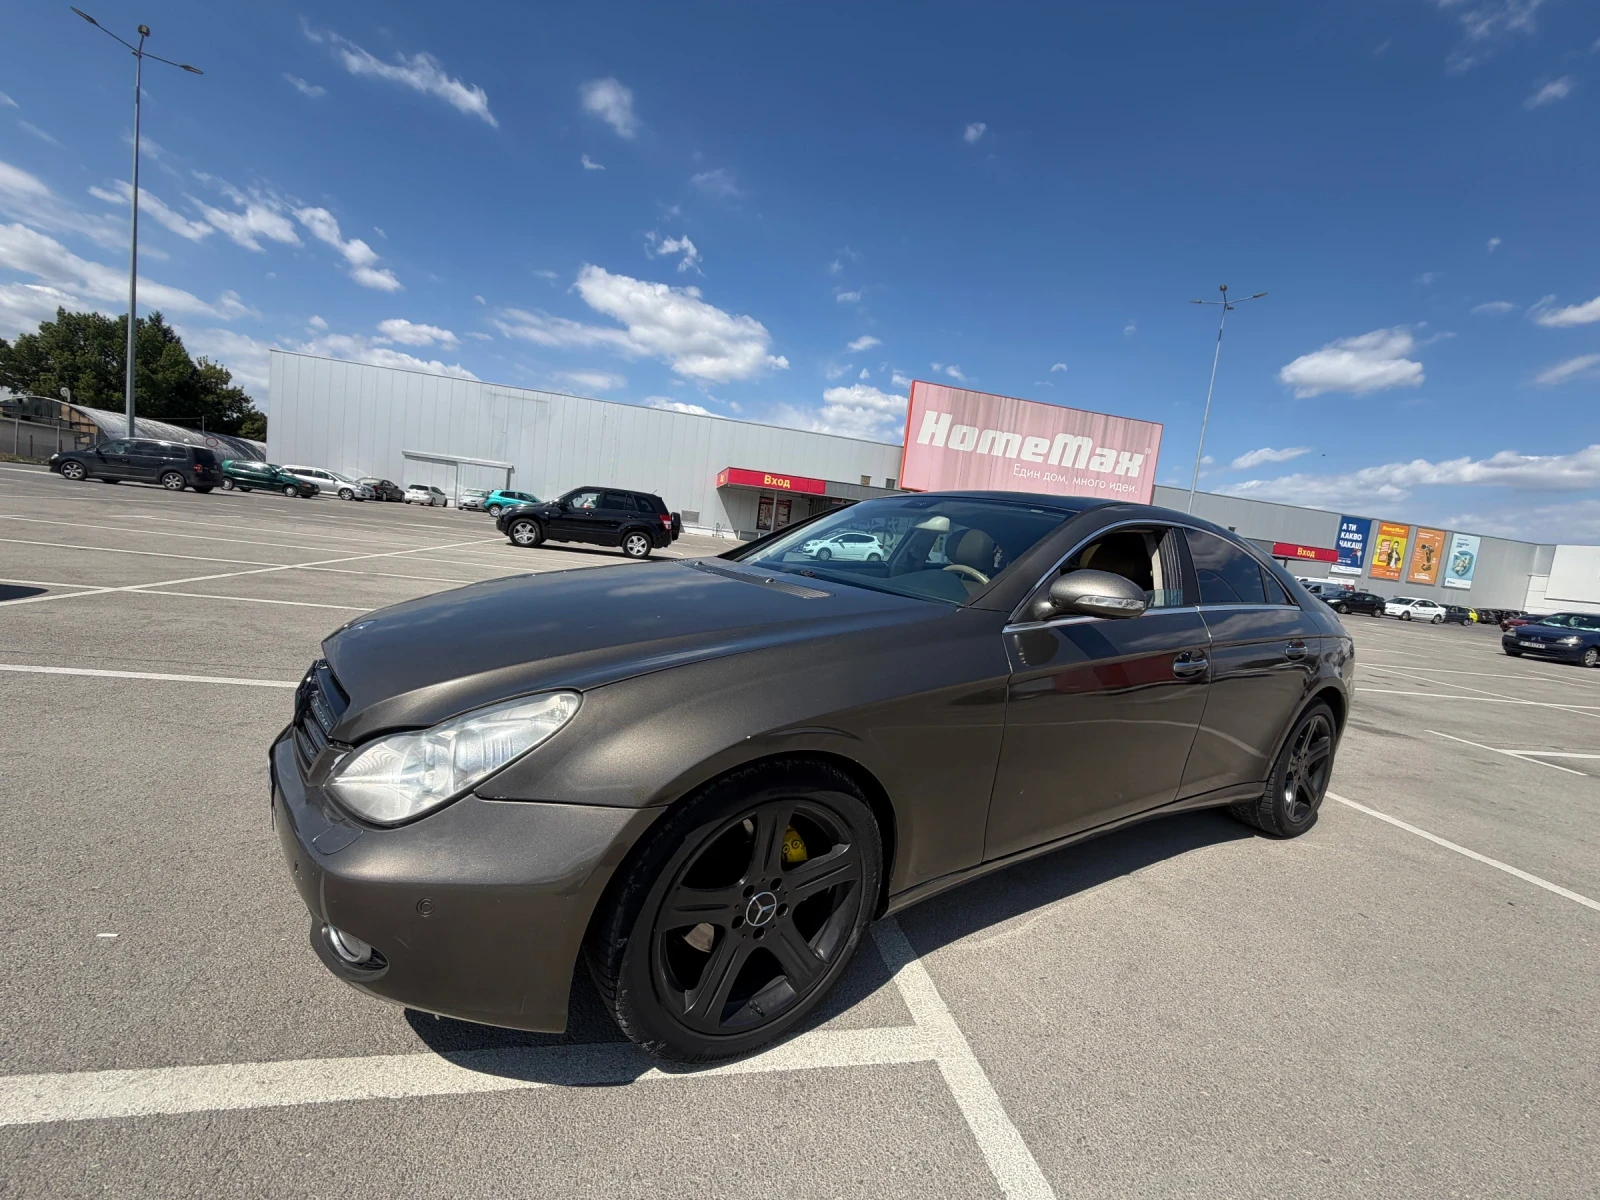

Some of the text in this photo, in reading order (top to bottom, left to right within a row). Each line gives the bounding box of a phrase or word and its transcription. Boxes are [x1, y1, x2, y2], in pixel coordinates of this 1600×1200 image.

[917, 410, 1145, 478] HomeMax
[764, 474, 790, 488] Вход
[1013, 463, 1138, 494] Един дом, много идеи.
[1348, 523, 1357, 531] ТИ
[1340, 531, 1362, 541] КАКВО
[1297, 547, 1315, 558] Вход
